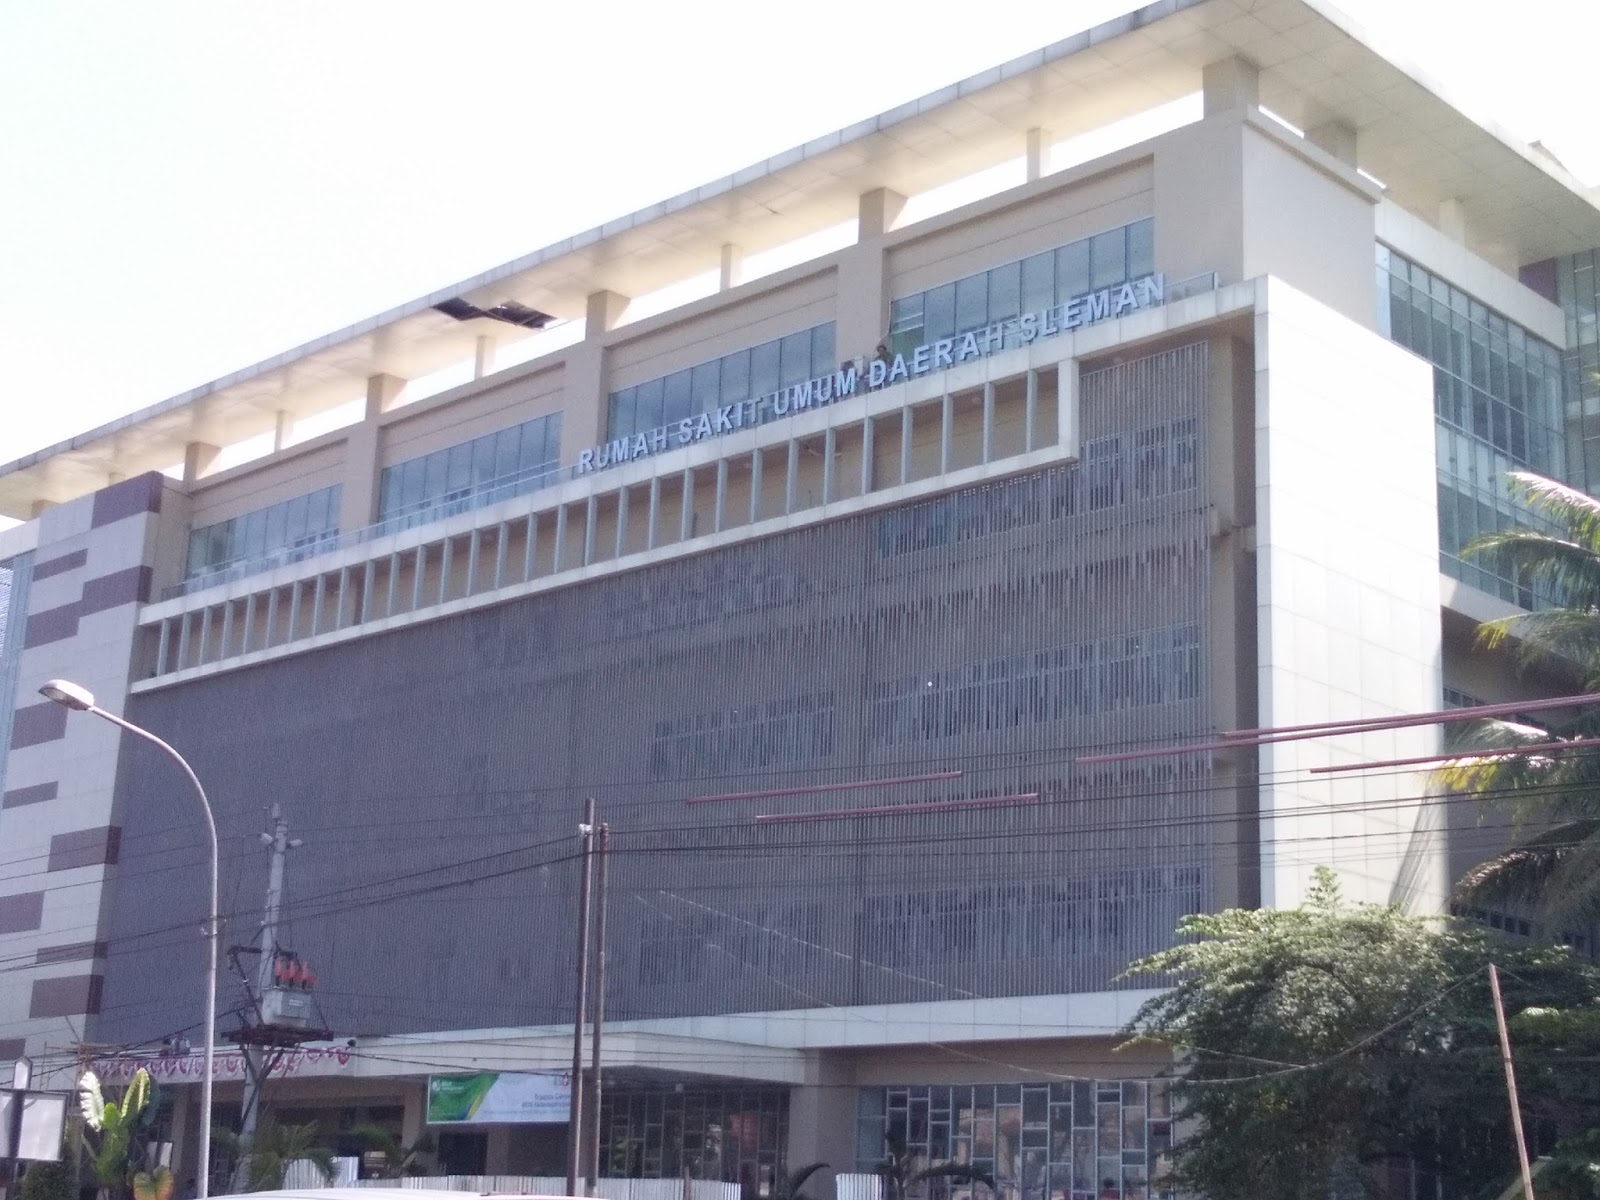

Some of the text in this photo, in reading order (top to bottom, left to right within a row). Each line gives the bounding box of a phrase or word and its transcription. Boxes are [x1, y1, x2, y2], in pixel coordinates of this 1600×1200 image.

[578, 272, 1165, 474] RUMAH SAKIT UMUM DAERAH SLEMAN
